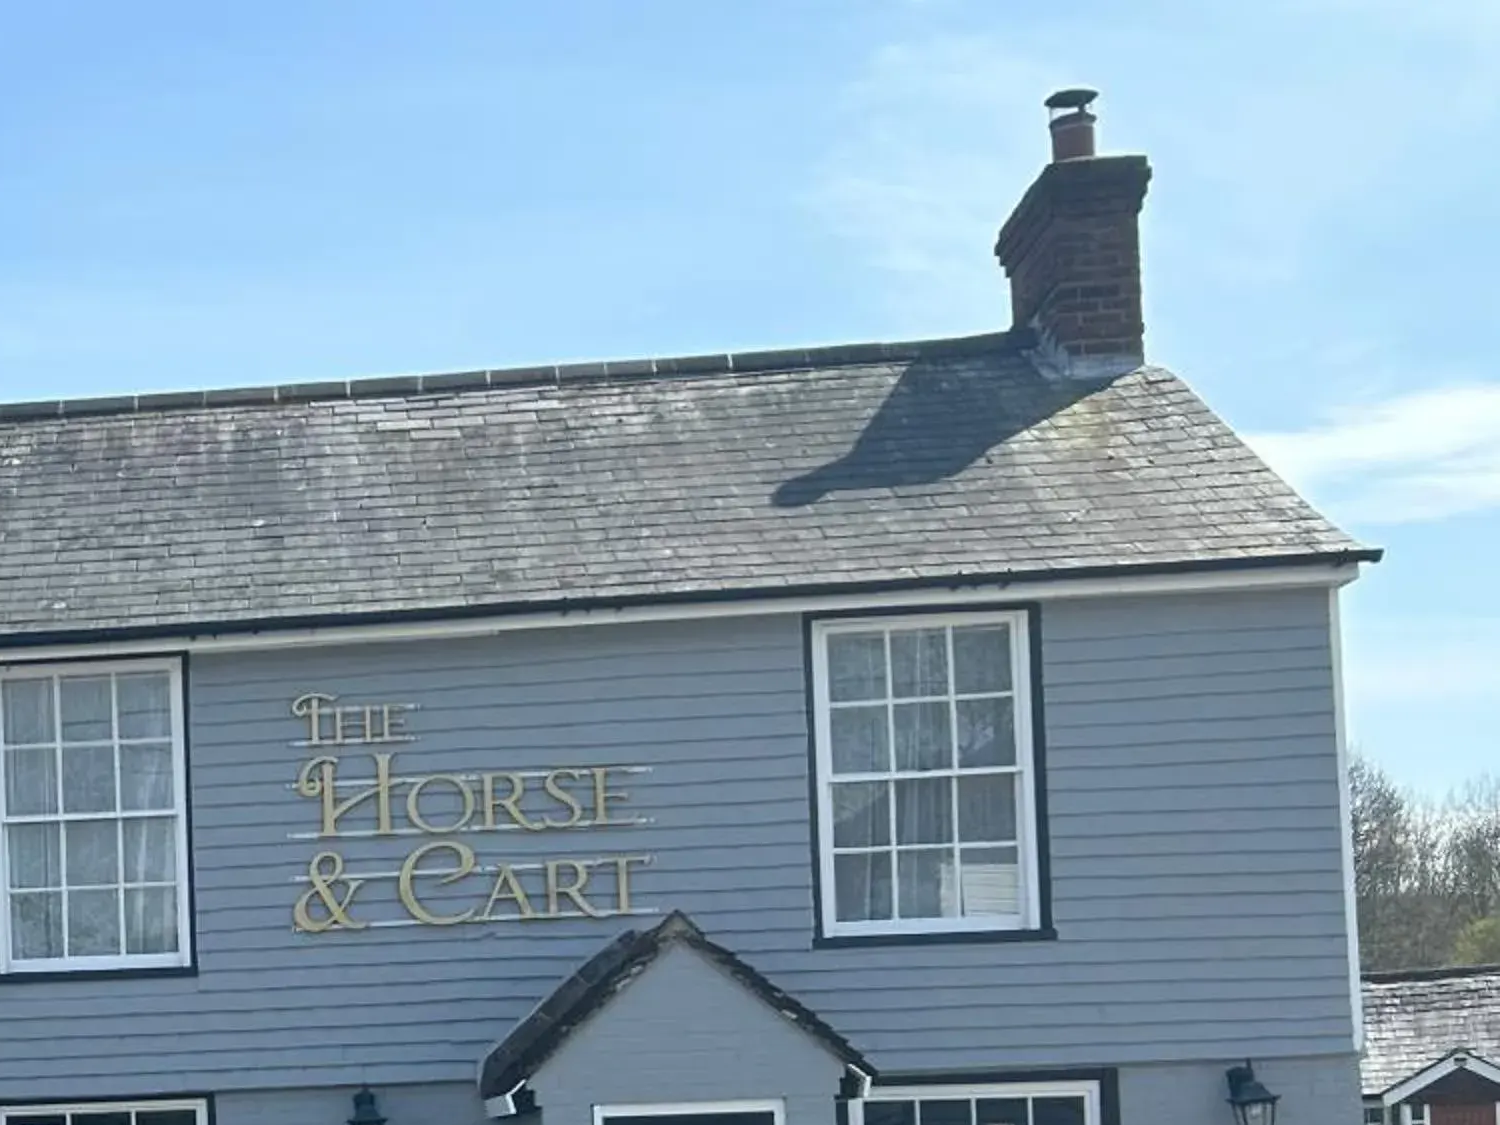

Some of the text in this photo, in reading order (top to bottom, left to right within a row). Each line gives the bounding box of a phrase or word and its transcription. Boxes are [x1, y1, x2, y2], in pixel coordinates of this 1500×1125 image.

[292, 692, 412, 745] THE
[297, 752, 634, 837] HORSE
[292, 840, 653, 932] & CART
